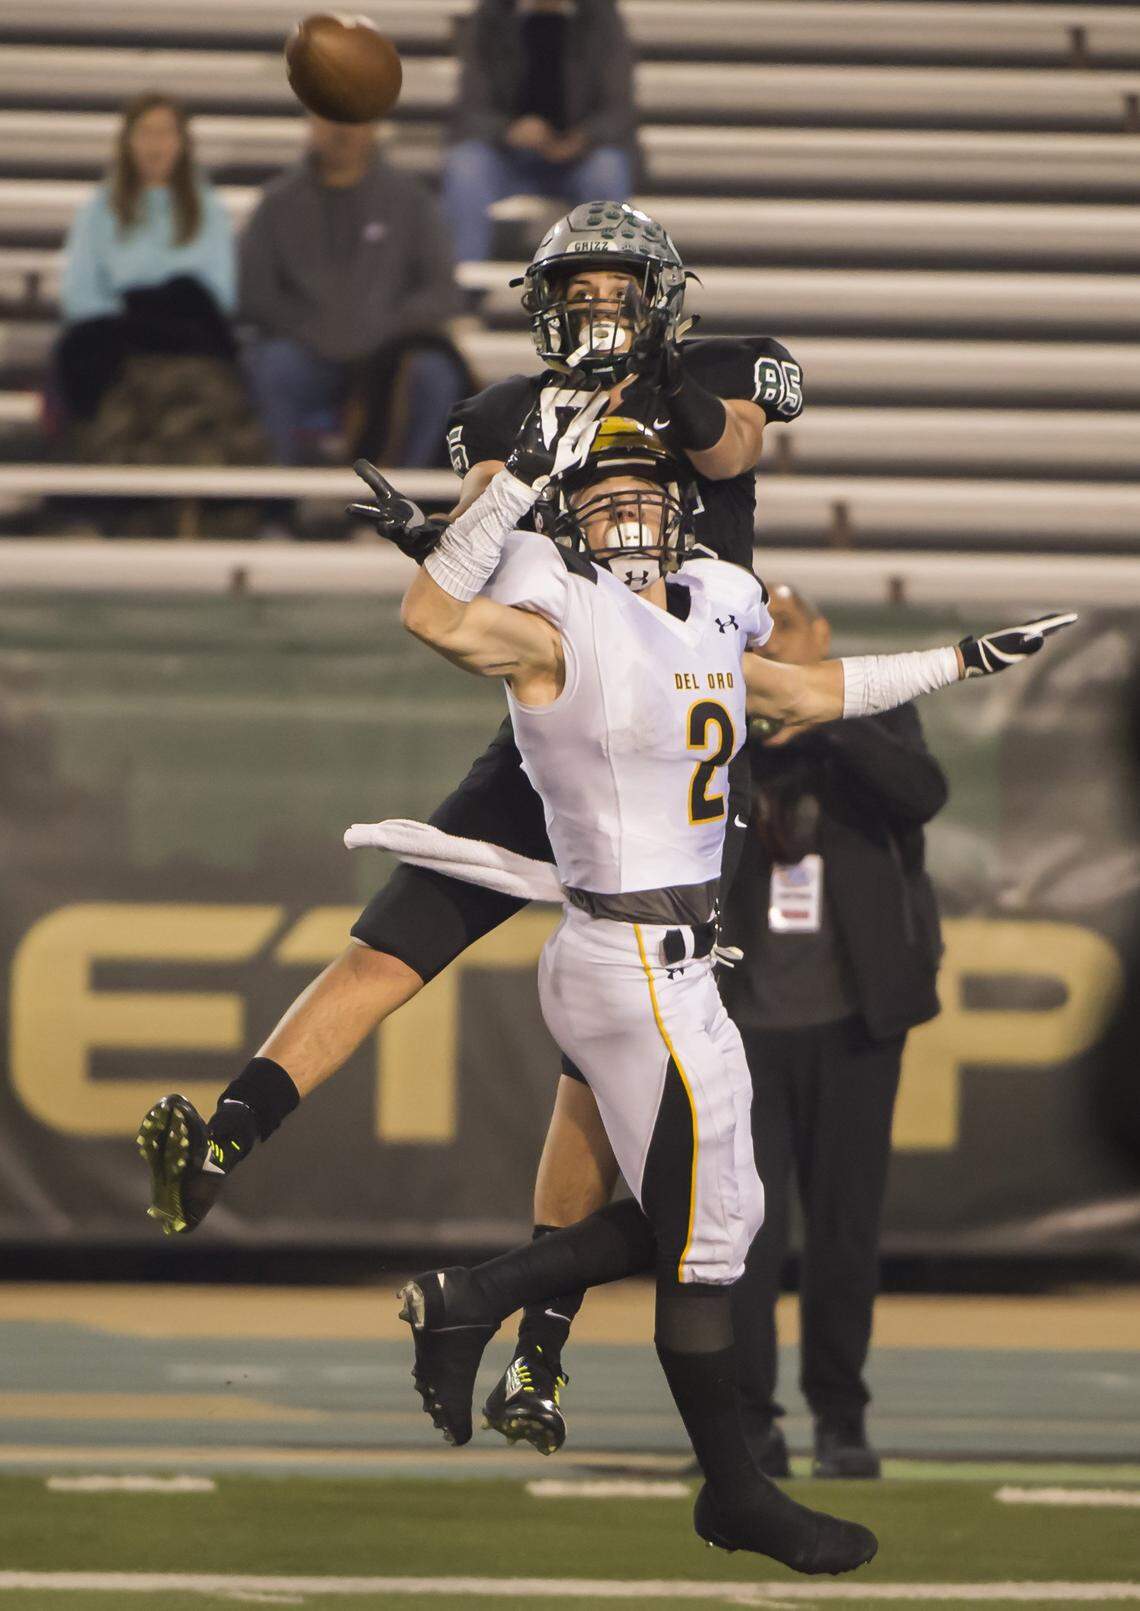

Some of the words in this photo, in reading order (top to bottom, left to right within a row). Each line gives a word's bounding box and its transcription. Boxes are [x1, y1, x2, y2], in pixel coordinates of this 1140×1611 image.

[574, 241, 609, 252] GRIZZ
[752, 357, 803, 416] 85
[674, 673, 700, 690] DEL
[707, 672, 734, 689] ORO
[686, 698, 736, 825] 2
